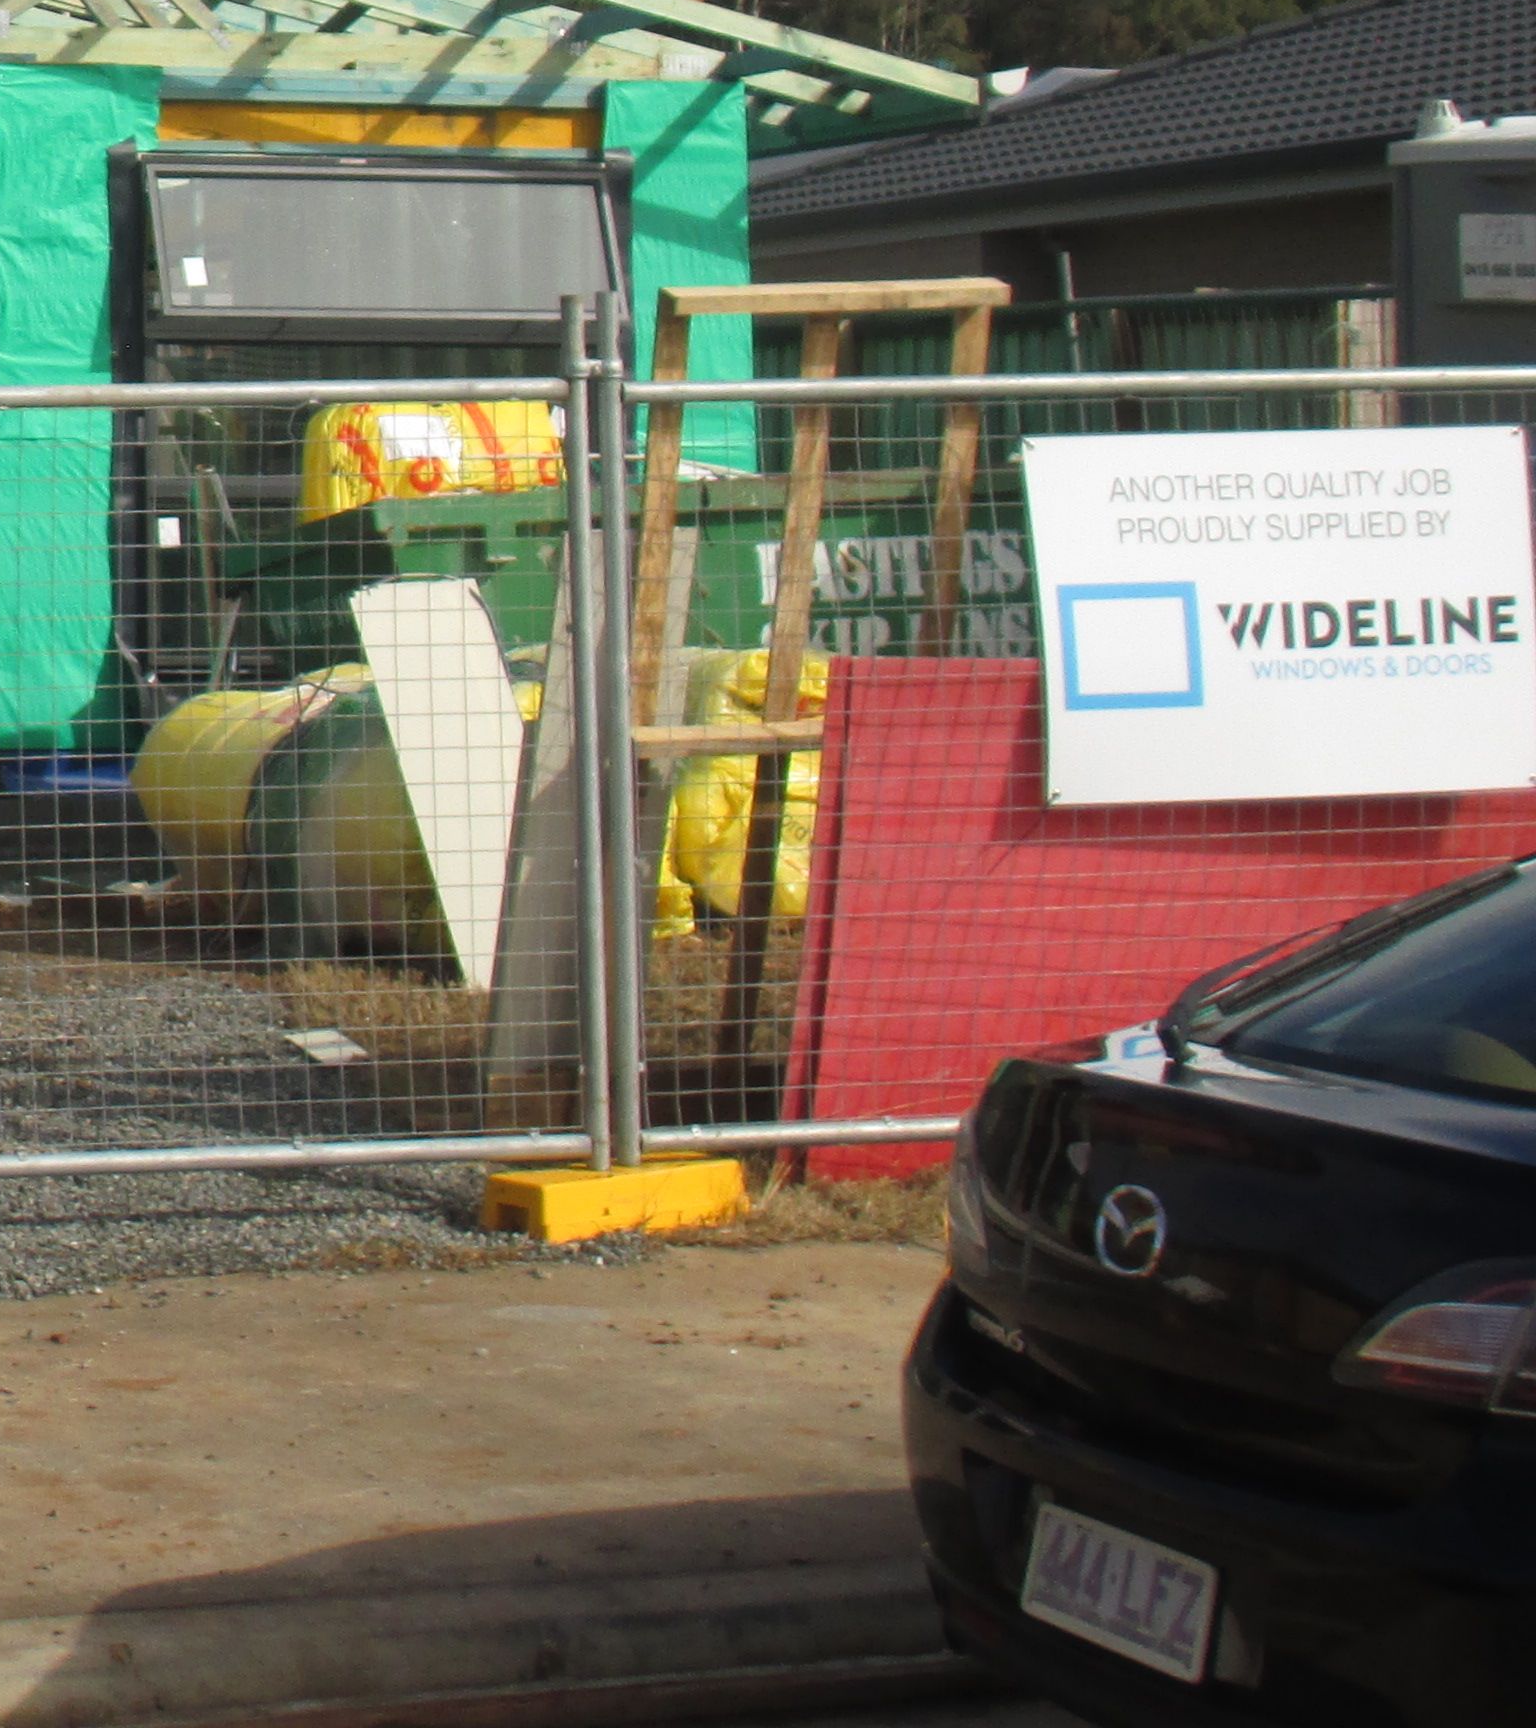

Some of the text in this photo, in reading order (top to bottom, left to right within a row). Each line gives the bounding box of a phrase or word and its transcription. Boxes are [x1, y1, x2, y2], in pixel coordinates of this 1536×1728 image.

[1109, 468, 1452, 503] ANOTHER QUALITY JOB
[1118, 510, 1451, 544] PROUDLY SUPPLIED BY
[1216, 595, 1520, 650] WIDELINE
[1251, 653, 1493, 681] WINDOWS & DOORS
